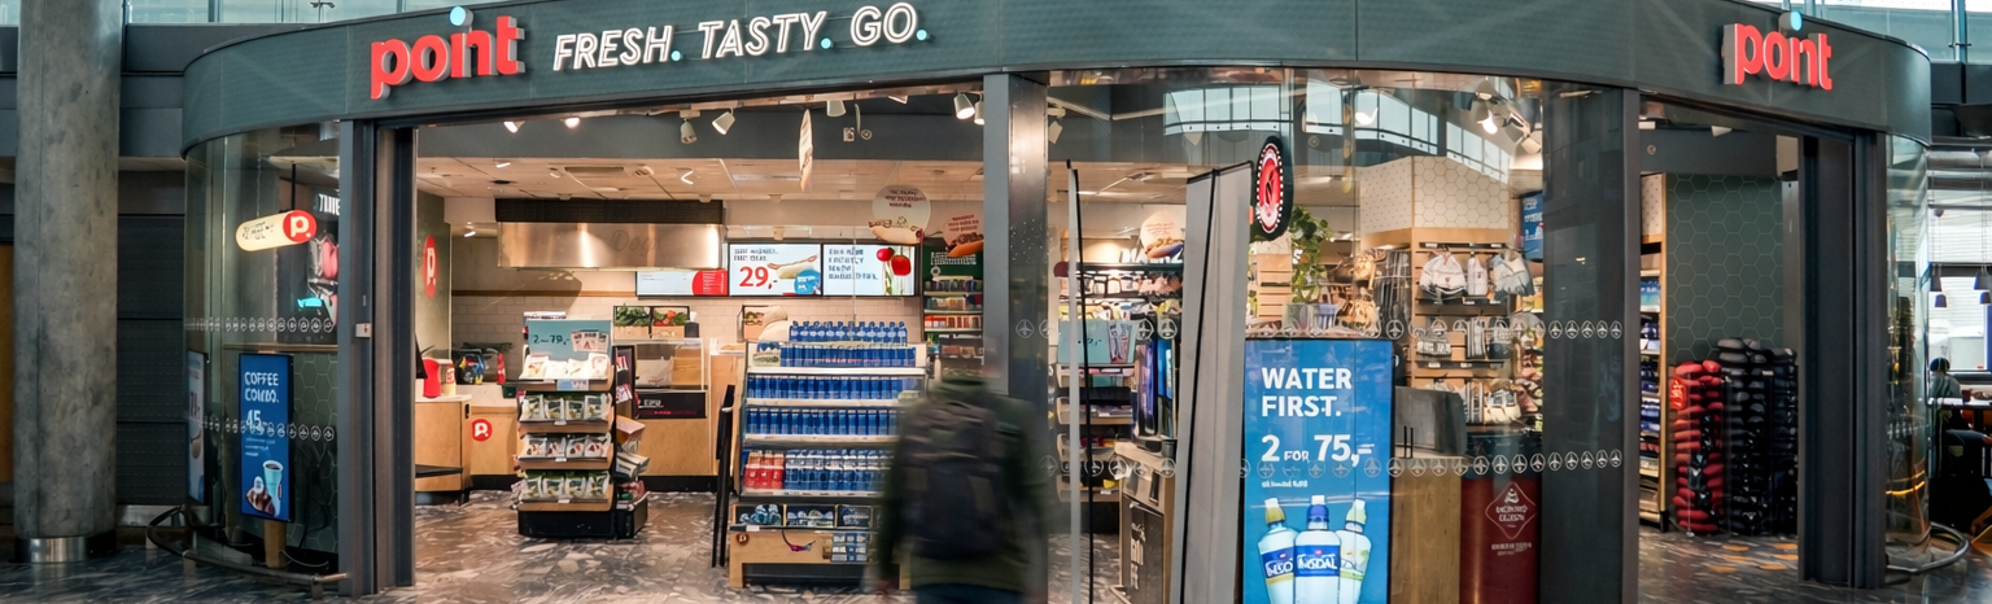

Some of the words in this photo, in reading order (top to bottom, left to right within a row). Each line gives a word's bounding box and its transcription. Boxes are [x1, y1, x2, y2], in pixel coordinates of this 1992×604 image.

[553, 25, 682, 71] FRESH.
[698, 11, 832, 59] TASTY.
[850, 2, 928, 47] GO.
[371, 6, 524, 100] point
[1724, 11, 1832, 91] point
[244, 371, 279, 386] COFFEE
[1261, 367, 1352, 390] WATER
[1261, 395, 1342, 417] FIRST.
[1261, 434, 1280, 462] 2
